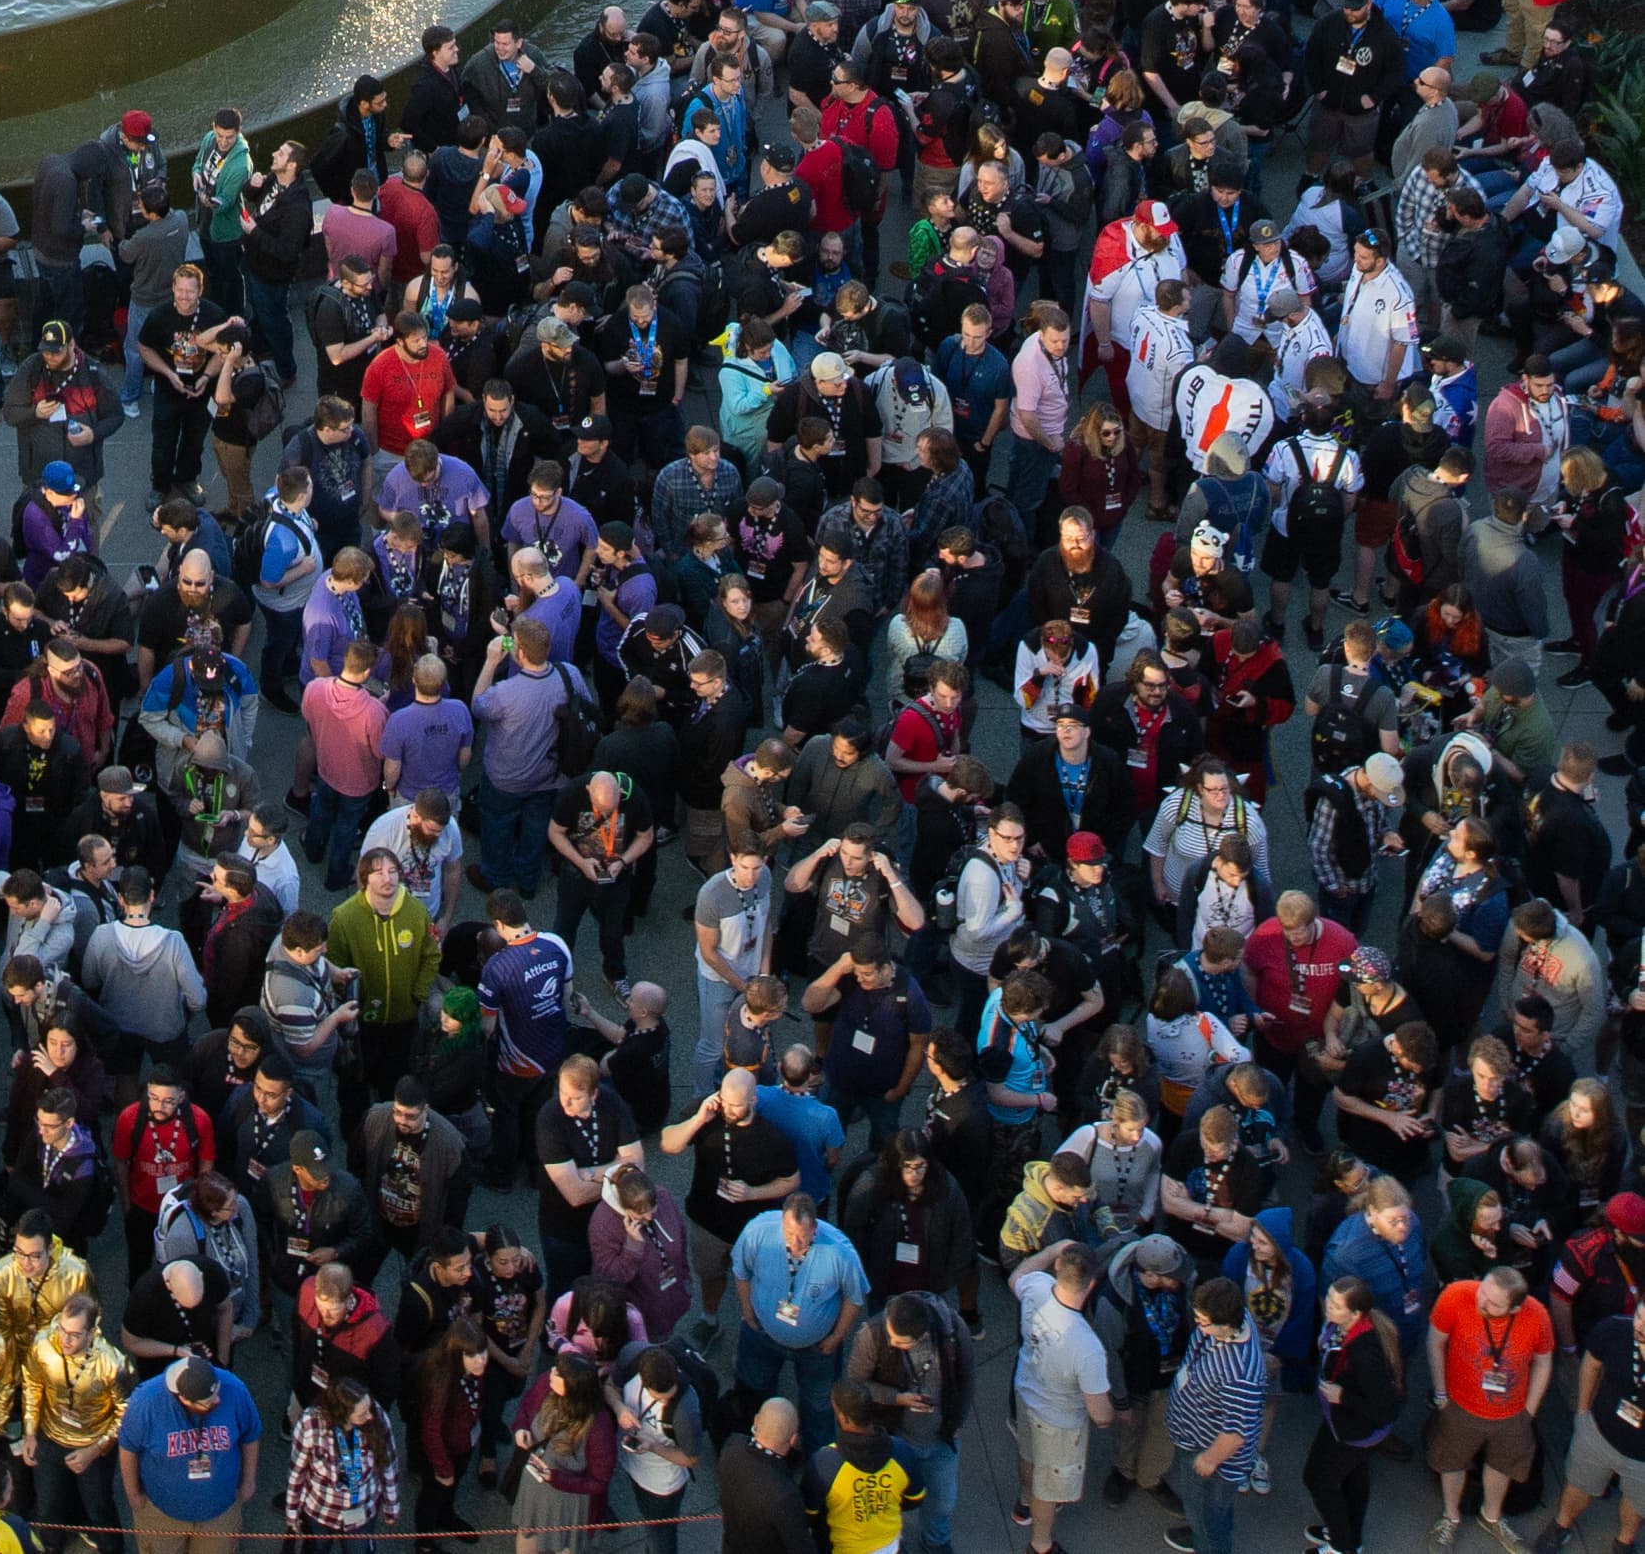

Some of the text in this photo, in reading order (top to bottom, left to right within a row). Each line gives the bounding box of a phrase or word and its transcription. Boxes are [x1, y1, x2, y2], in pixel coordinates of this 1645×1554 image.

[1185, 375, 1205, 437] CLUB
[524, 959, 559, 983] Atticus
[167, 1425, 231, 1458] KANSAS
[853, 1473, 892, 1494] CSC
